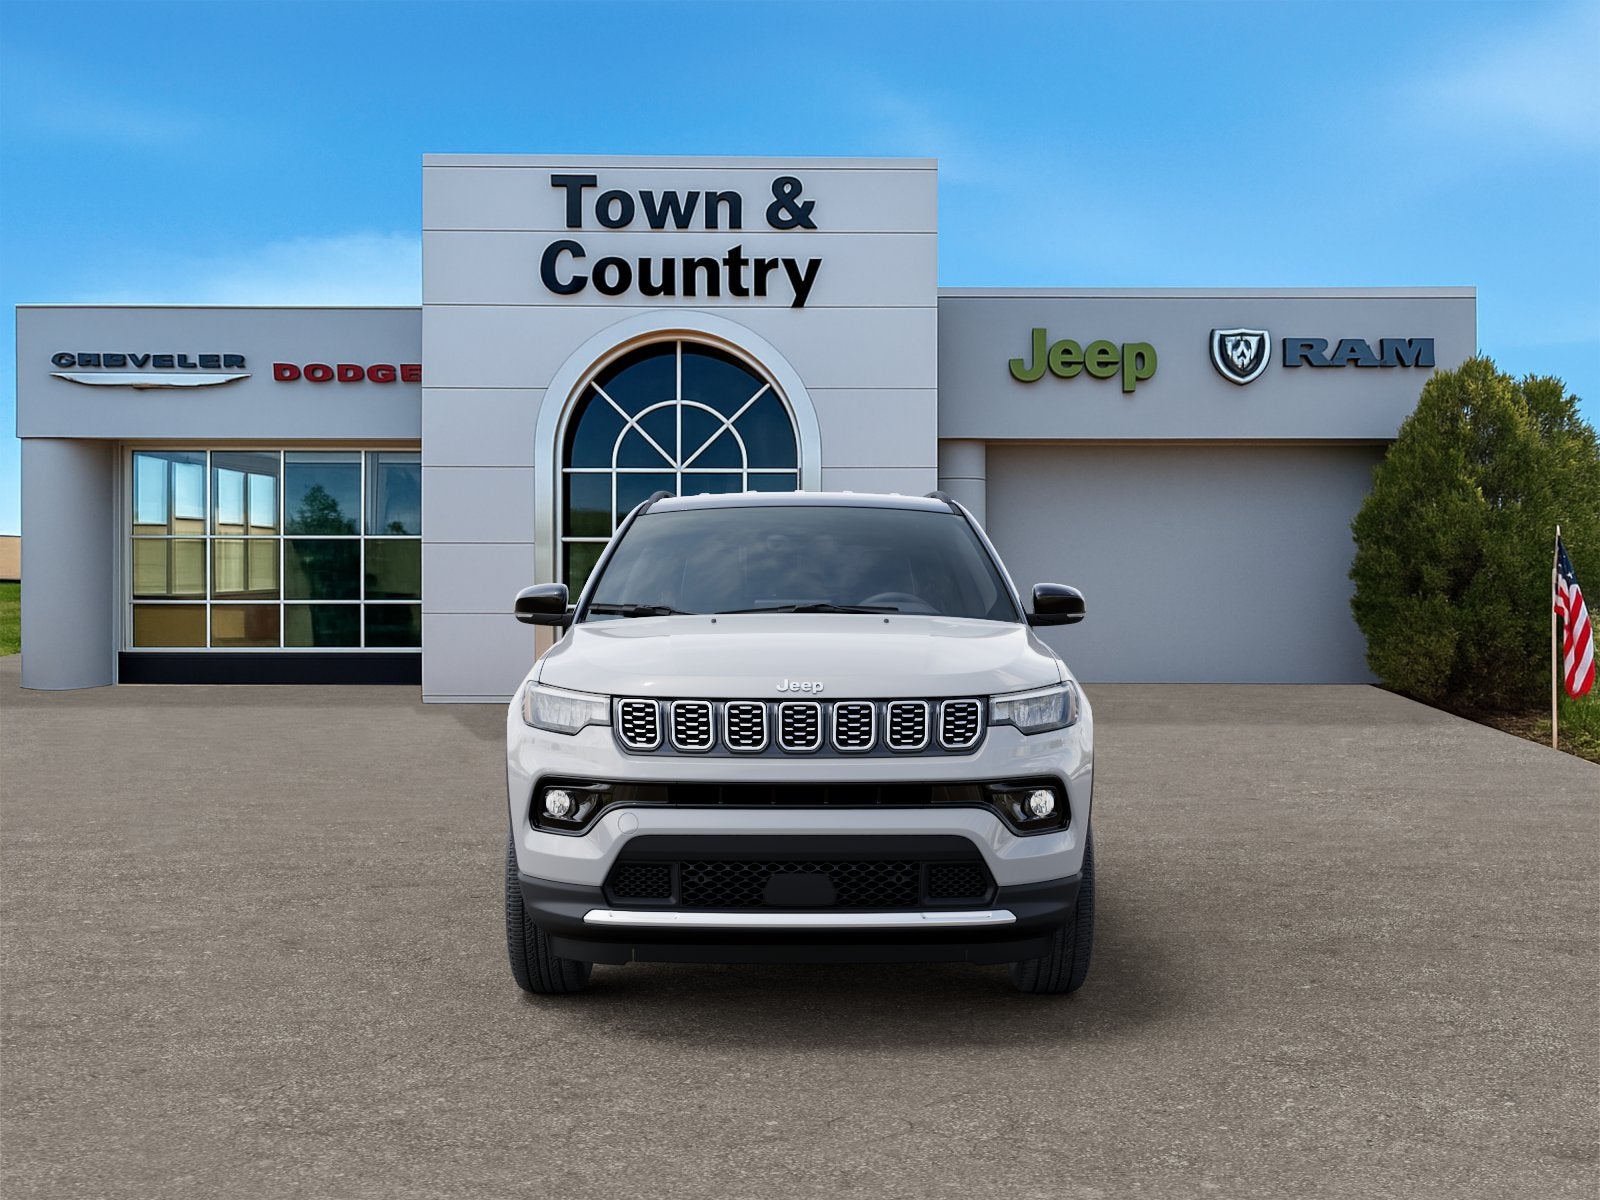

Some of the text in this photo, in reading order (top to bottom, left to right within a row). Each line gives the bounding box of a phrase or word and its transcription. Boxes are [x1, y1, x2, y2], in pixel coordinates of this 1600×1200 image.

[550, 174, 818, 230] Town &
[540, 239, 822, 308] Country
[273, 363, 422, 383] DODGE
[1009, 327, 1157, 392] Jeep
[1282, 337, 1435, 368] RAM
[776, 678, 824, 694] Jeep
